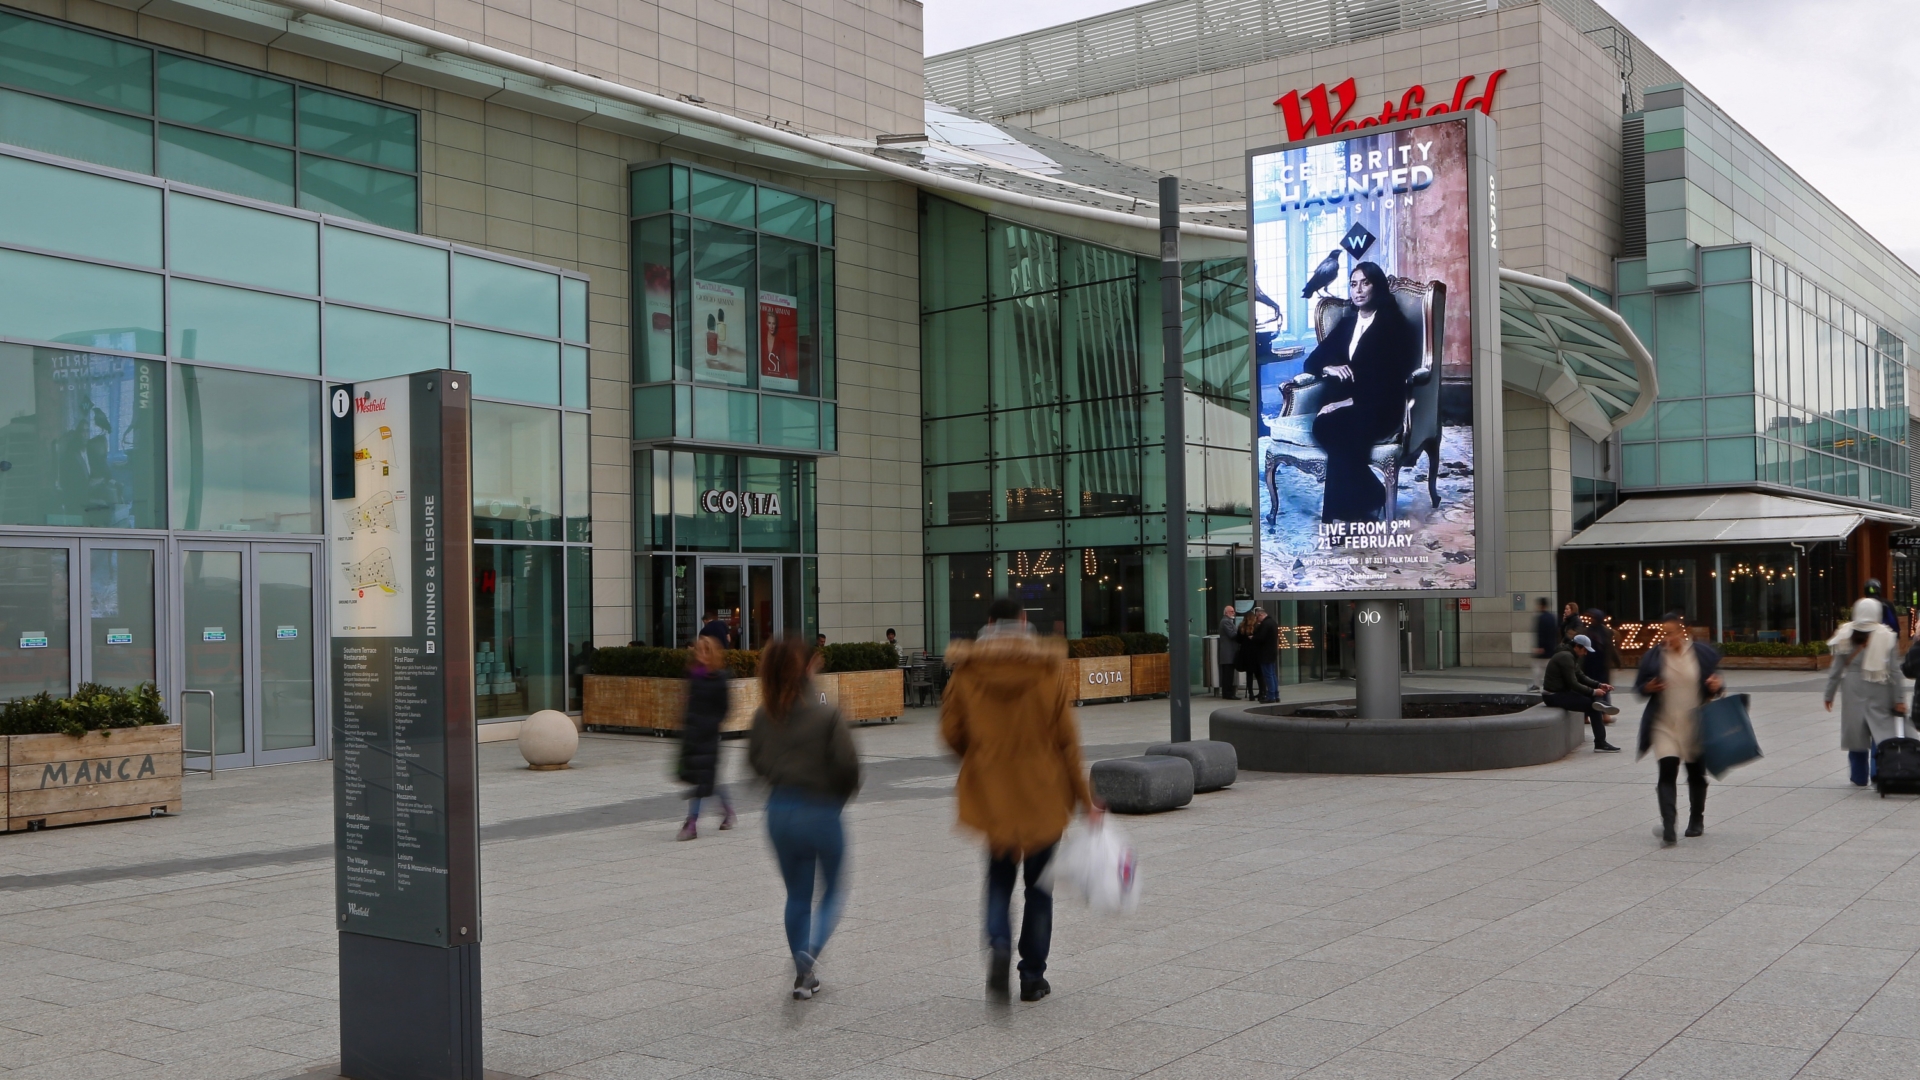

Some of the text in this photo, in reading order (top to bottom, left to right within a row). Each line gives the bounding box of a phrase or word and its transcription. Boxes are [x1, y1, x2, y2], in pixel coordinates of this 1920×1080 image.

[1280, 141, 1433, 183] CELEBRITY
[1280, 165, 1433, 211] HAUNTED
[1300, 196, 1413, 222] MANSION
[1489, 174, 1497, 249] OCEAN
[1348, 234, 1367, 249] W
[355, 397, 387, 413] Westfield
[702, 489, 781, 517] COSTA
[1319, 519, 1411, 536] LIVE FROM 9PM
[1318, 534, 1413, 550] 21ST FEBRUARY
[425, 495, 436, 636] DINING & LEISURE
[1088, 671, 1123, 685] COSTA
[40, 753, 156, 790] MANCA
[355, 857, 368, 866] Village
[411, 864, 431, 872] Mezzanine
[348, 903, 370, 917] Westfield
